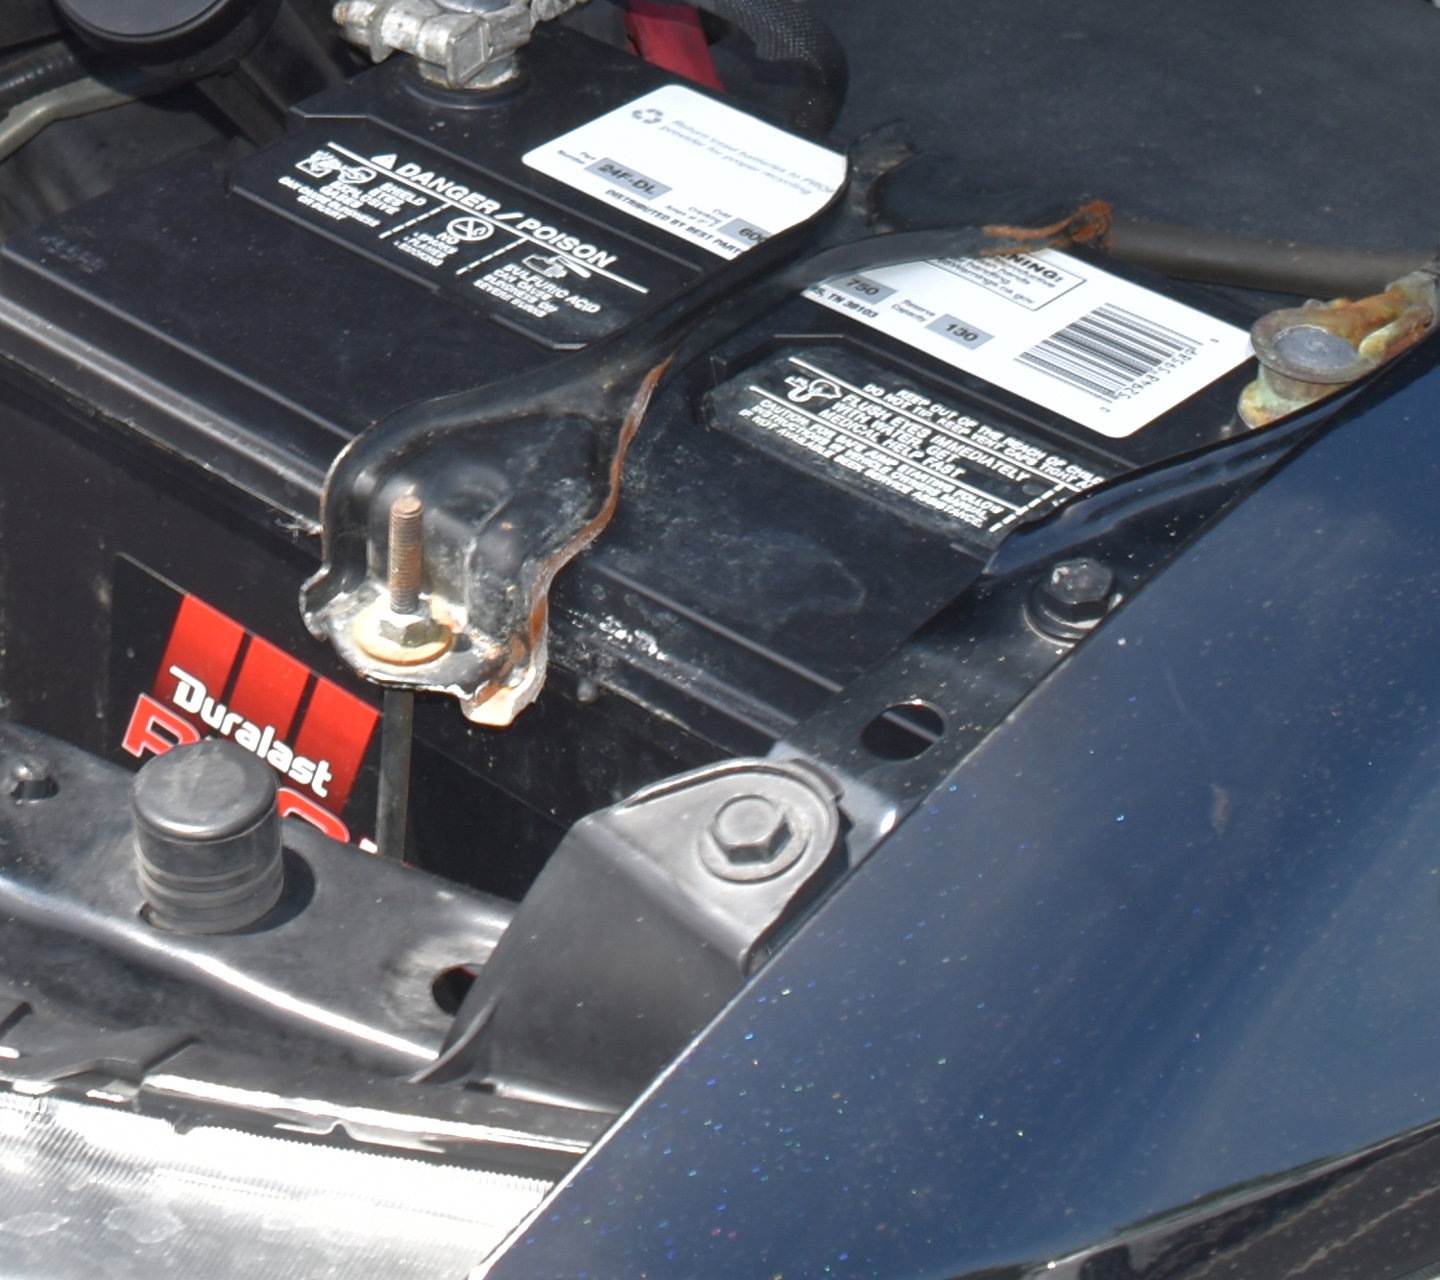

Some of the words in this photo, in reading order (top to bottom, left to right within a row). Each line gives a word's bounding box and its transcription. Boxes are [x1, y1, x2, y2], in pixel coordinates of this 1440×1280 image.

[327, 179, 400, 215] EXPLOSIVE
[376, 181, 427, 206] SHIELD
[598, 163, 654, 194] 24F-DL
[394, 162, 500, 214] DANGER
[515, 217, 616, 268] POISON
[435, 231, 460, 247] NO
[604, 189, 670, 220] DISTRIBUTED
[669, 218, 686, 227] BY
[685, 225, 713, 239] BEST
[499, 263, 569, 298] SULFURIC
[563, 294, 600, 313] ACID
[845, 276, 879, 295] 750
[946, 323, 978, 341] 130
[749, 403, 831, 447] INSTRUCTIONS
[840, 448, 893, 476] VEHICLE
[774, 425, 836, 458] AVAILABLE
[817, 408, 881, 443] MEDICAL
[880, 436, 925, 462] HELP
[921, 453, 965, 480] FAST
[830, 401, 871, 425] WITH
[925, 444, 960, 463] GET
[840, 393, 893, 421] FLUSH
[888, 415, 932, 439] EYES
[929, 433, 1031, 481] IMMEDIATELY
[862, 383, 885, 396] DO
[882, 392, 915, 409] NOT
[935, 416, 971, 434] KEEP
[969, 431, 1005, 450] VENT
[1003, 446, 1039, 466] CAPS
[1038, 461, 1078, 483] TIGHT
[894, 389, 931, 407] KEEP
[928, 403, 958, 419] OUT
[956, 416, 978, 427] OF
[976, 424, 1005, 441] THE
[999, 436, 1047, 460] REACH
[1044, 455, 1067, 468] OF
[806, 422, 837, 440] FOR
[951, 487, 1004, 513] FOLLOW
[169, 664, 334, 798] Duralast
